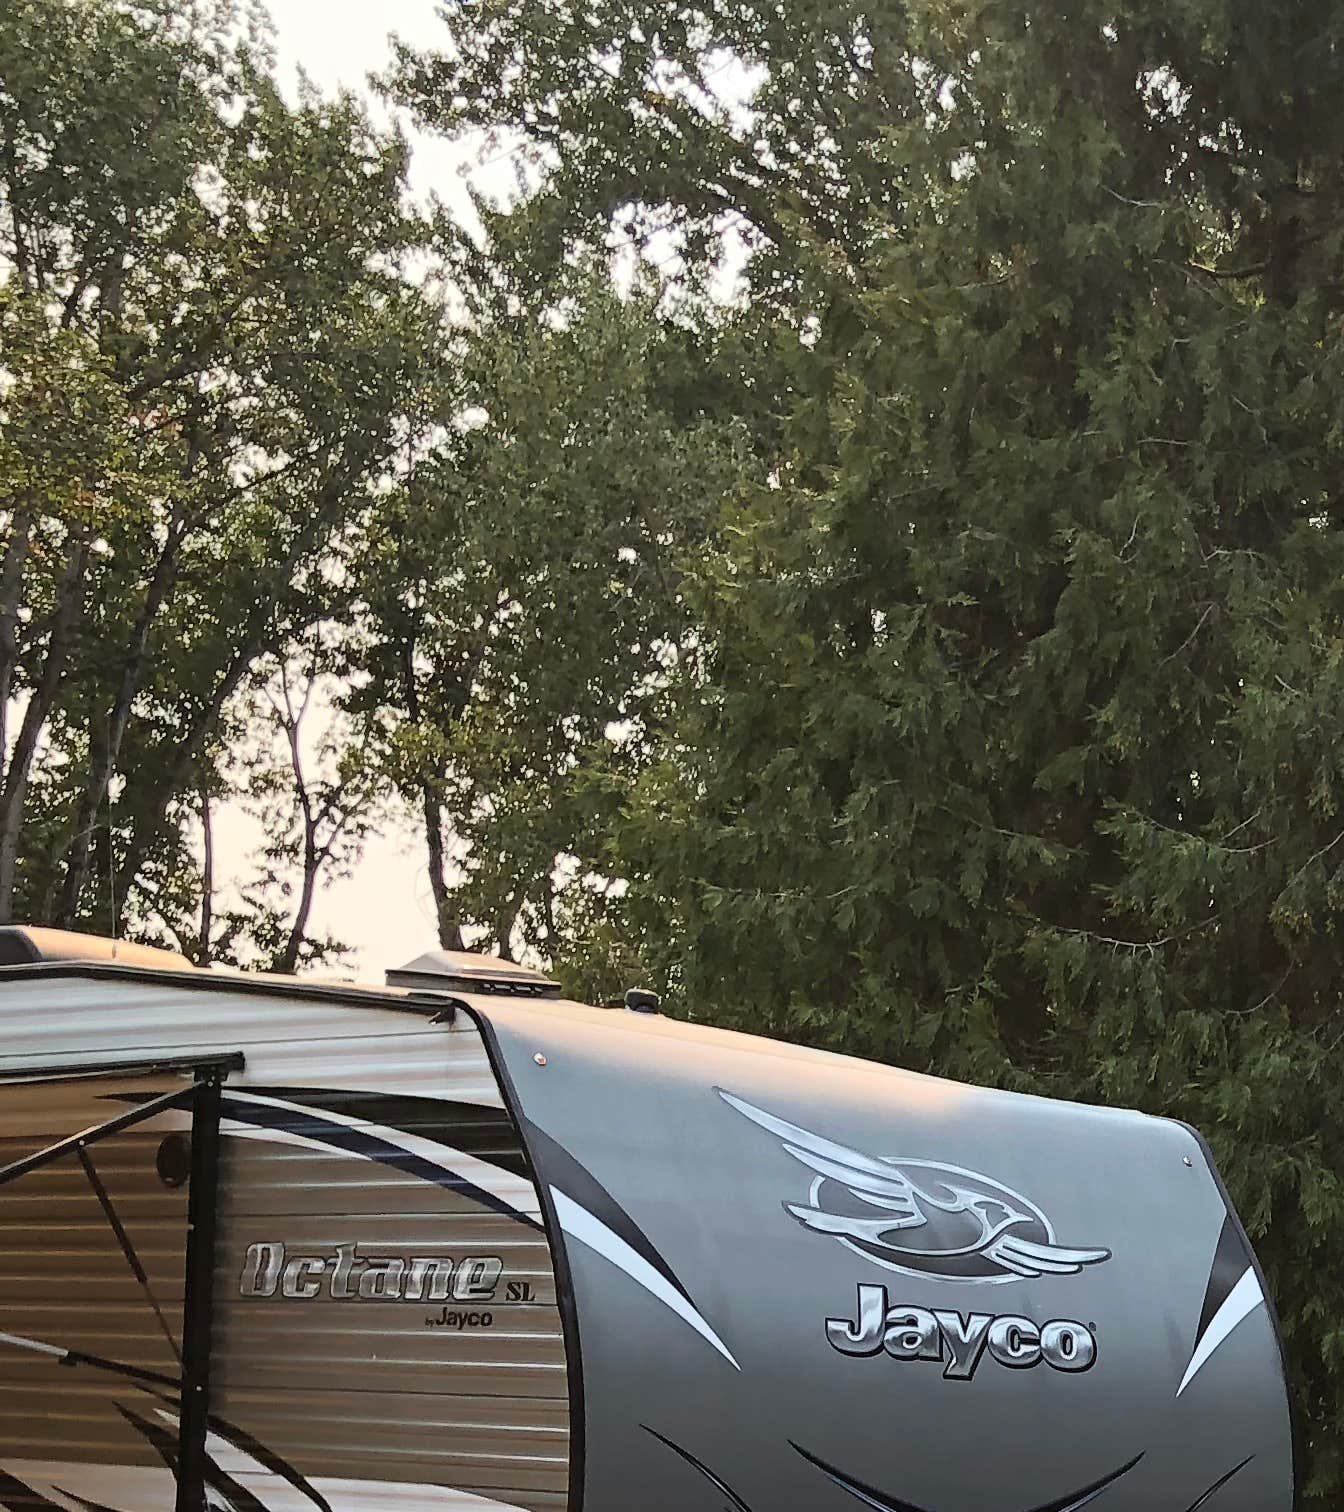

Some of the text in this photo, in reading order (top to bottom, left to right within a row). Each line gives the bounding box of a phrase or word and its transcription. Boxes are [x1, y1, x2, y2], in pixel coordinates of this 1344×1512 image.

[240, 1241, 536, 1301] Octane SL
[435, 1306, 493, 1330] Jayco
[824, 1283, 1098, 1381] Jayco
